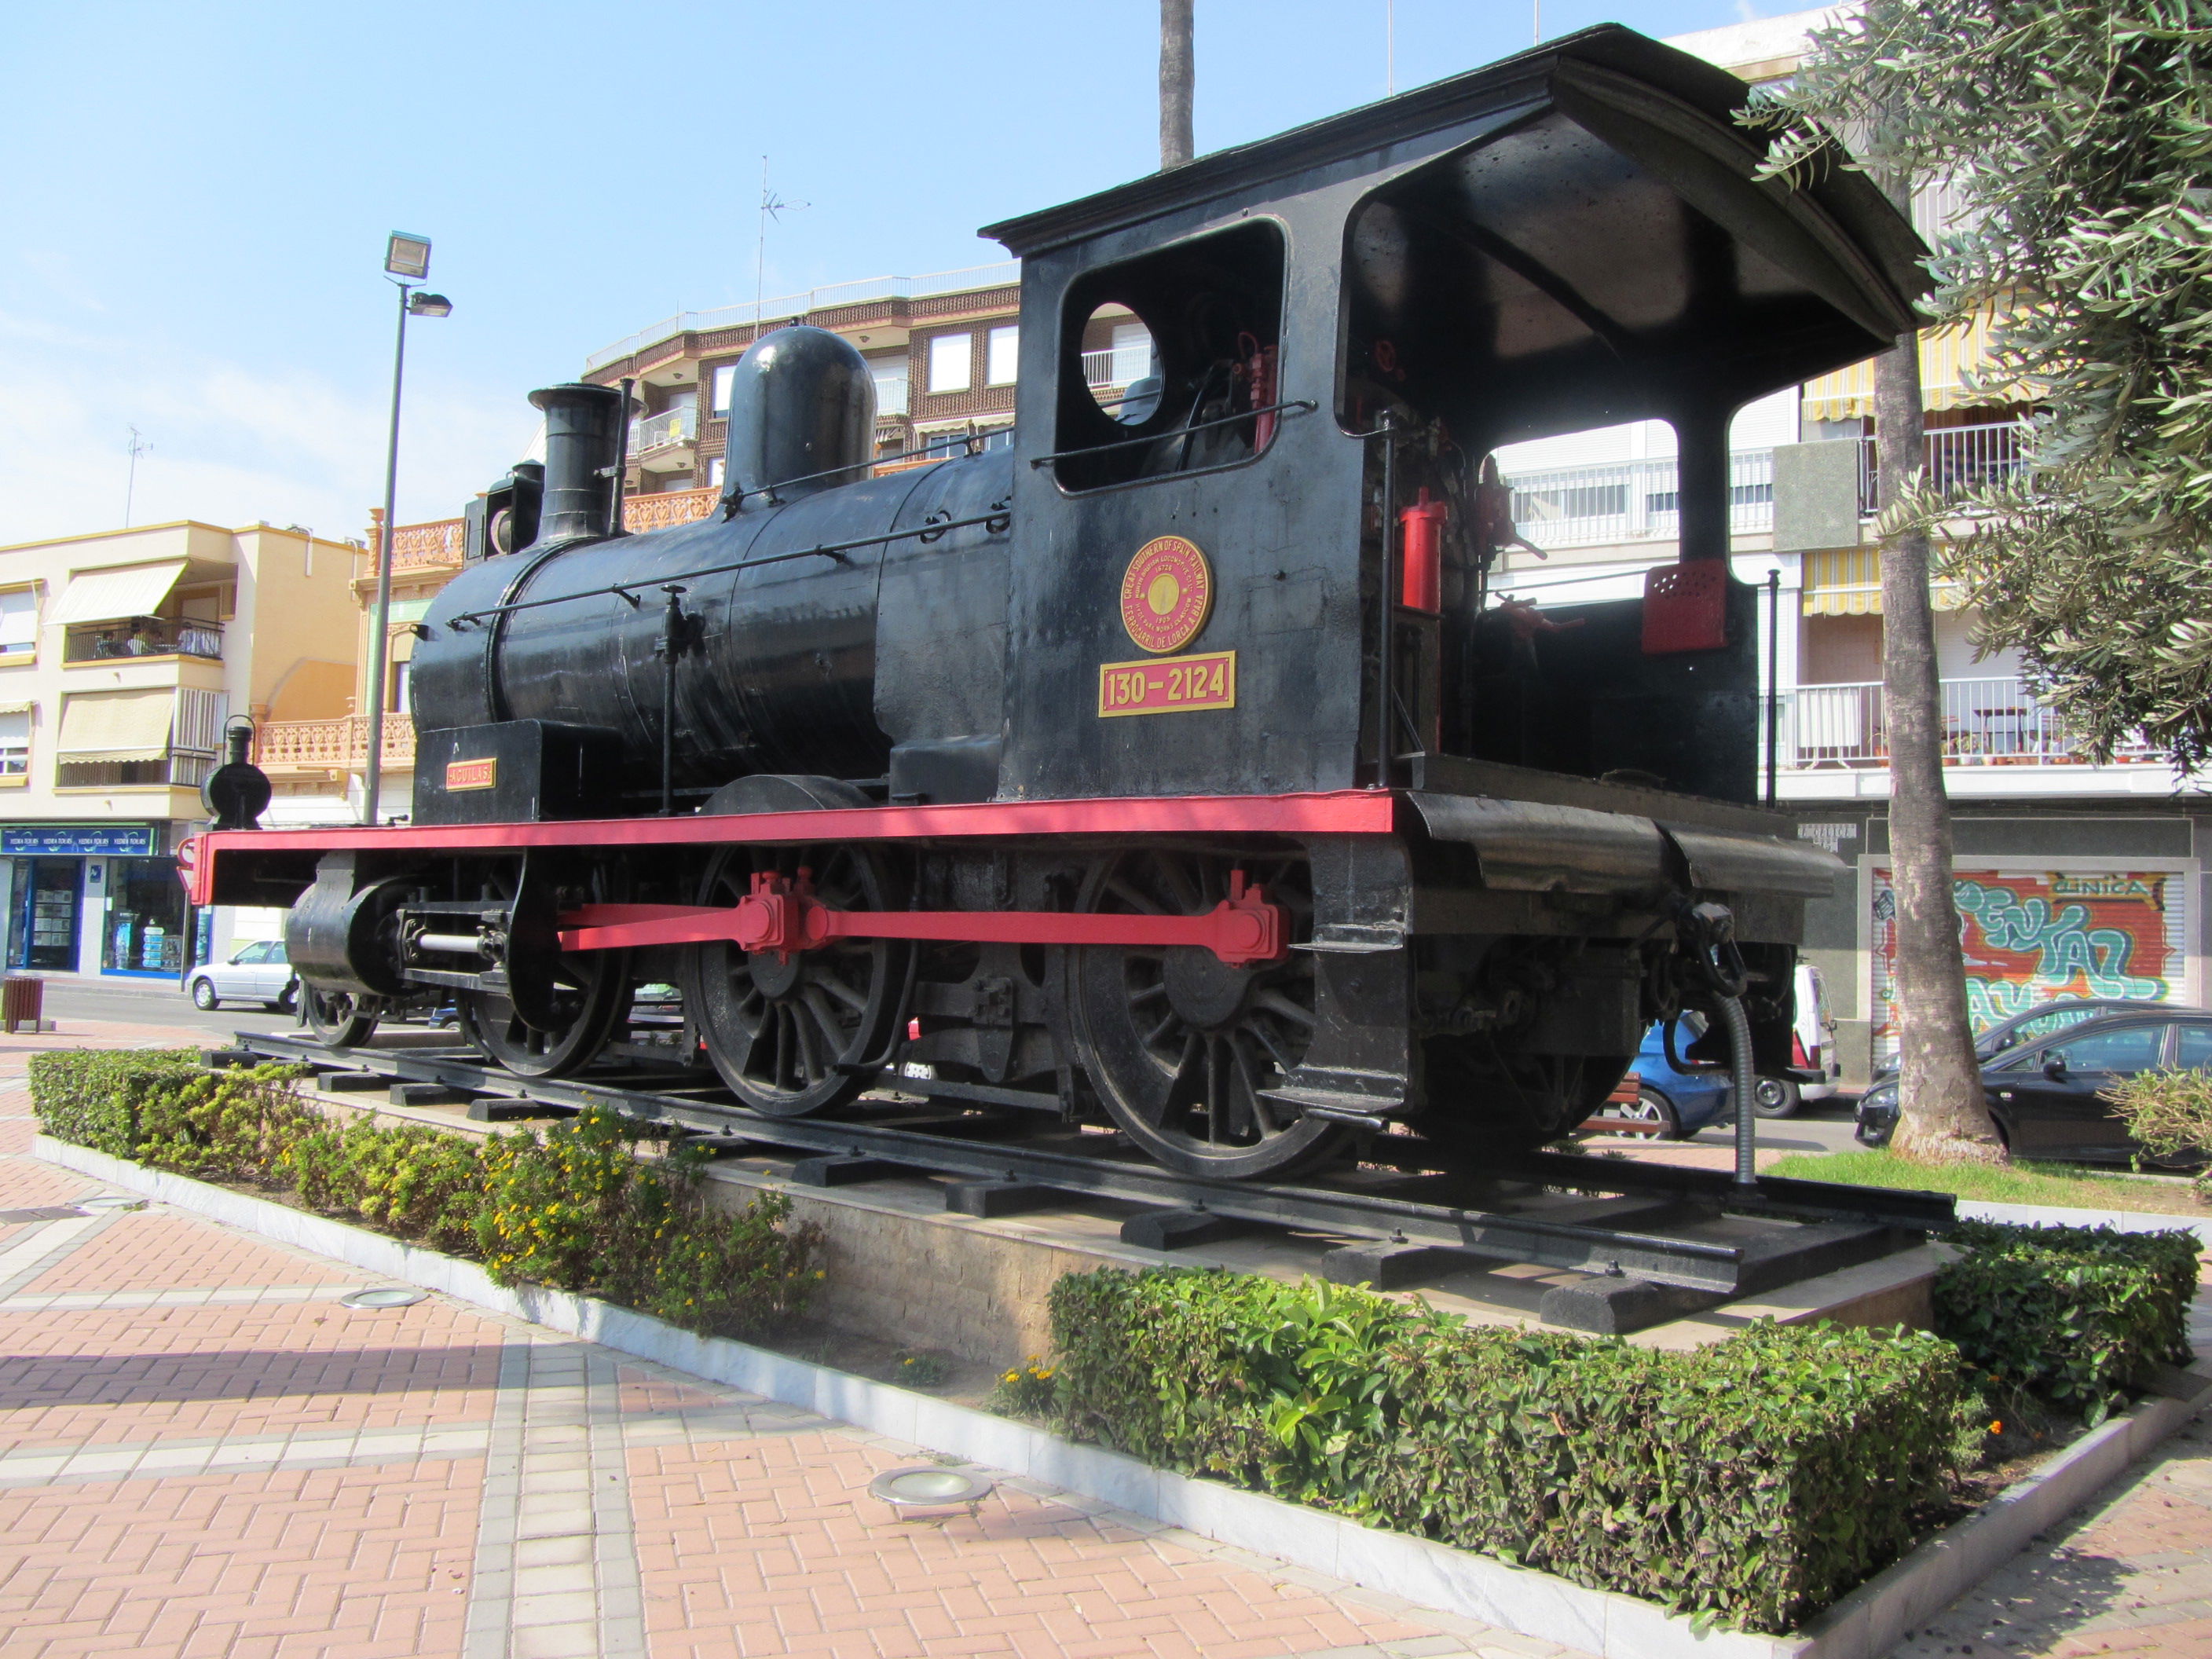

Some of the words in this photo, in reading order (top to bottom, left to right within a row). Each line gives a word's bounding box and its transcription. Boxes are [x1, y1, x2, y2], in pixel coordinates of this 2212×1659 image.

[1124, 571, 1137, 599] GREAT
[1132, 542, 1163, 572] SOUTHERN
[1164, 540, 1173, 551] OF
[1173, 540, 1192, 558] SPAIN
[1188, 555, 1205, 589] RAILWAY
[1191, 595, 1204, 617] BAZA
[1124, 605, 1155, 647] FERROCARRIL
[1188, 617, 1196, 625] A
[1157, 636, 1166, 648] DE
[1167, 624, 1190, 646] LORCA
[1108, 663, 1225, 705] 130-2124
